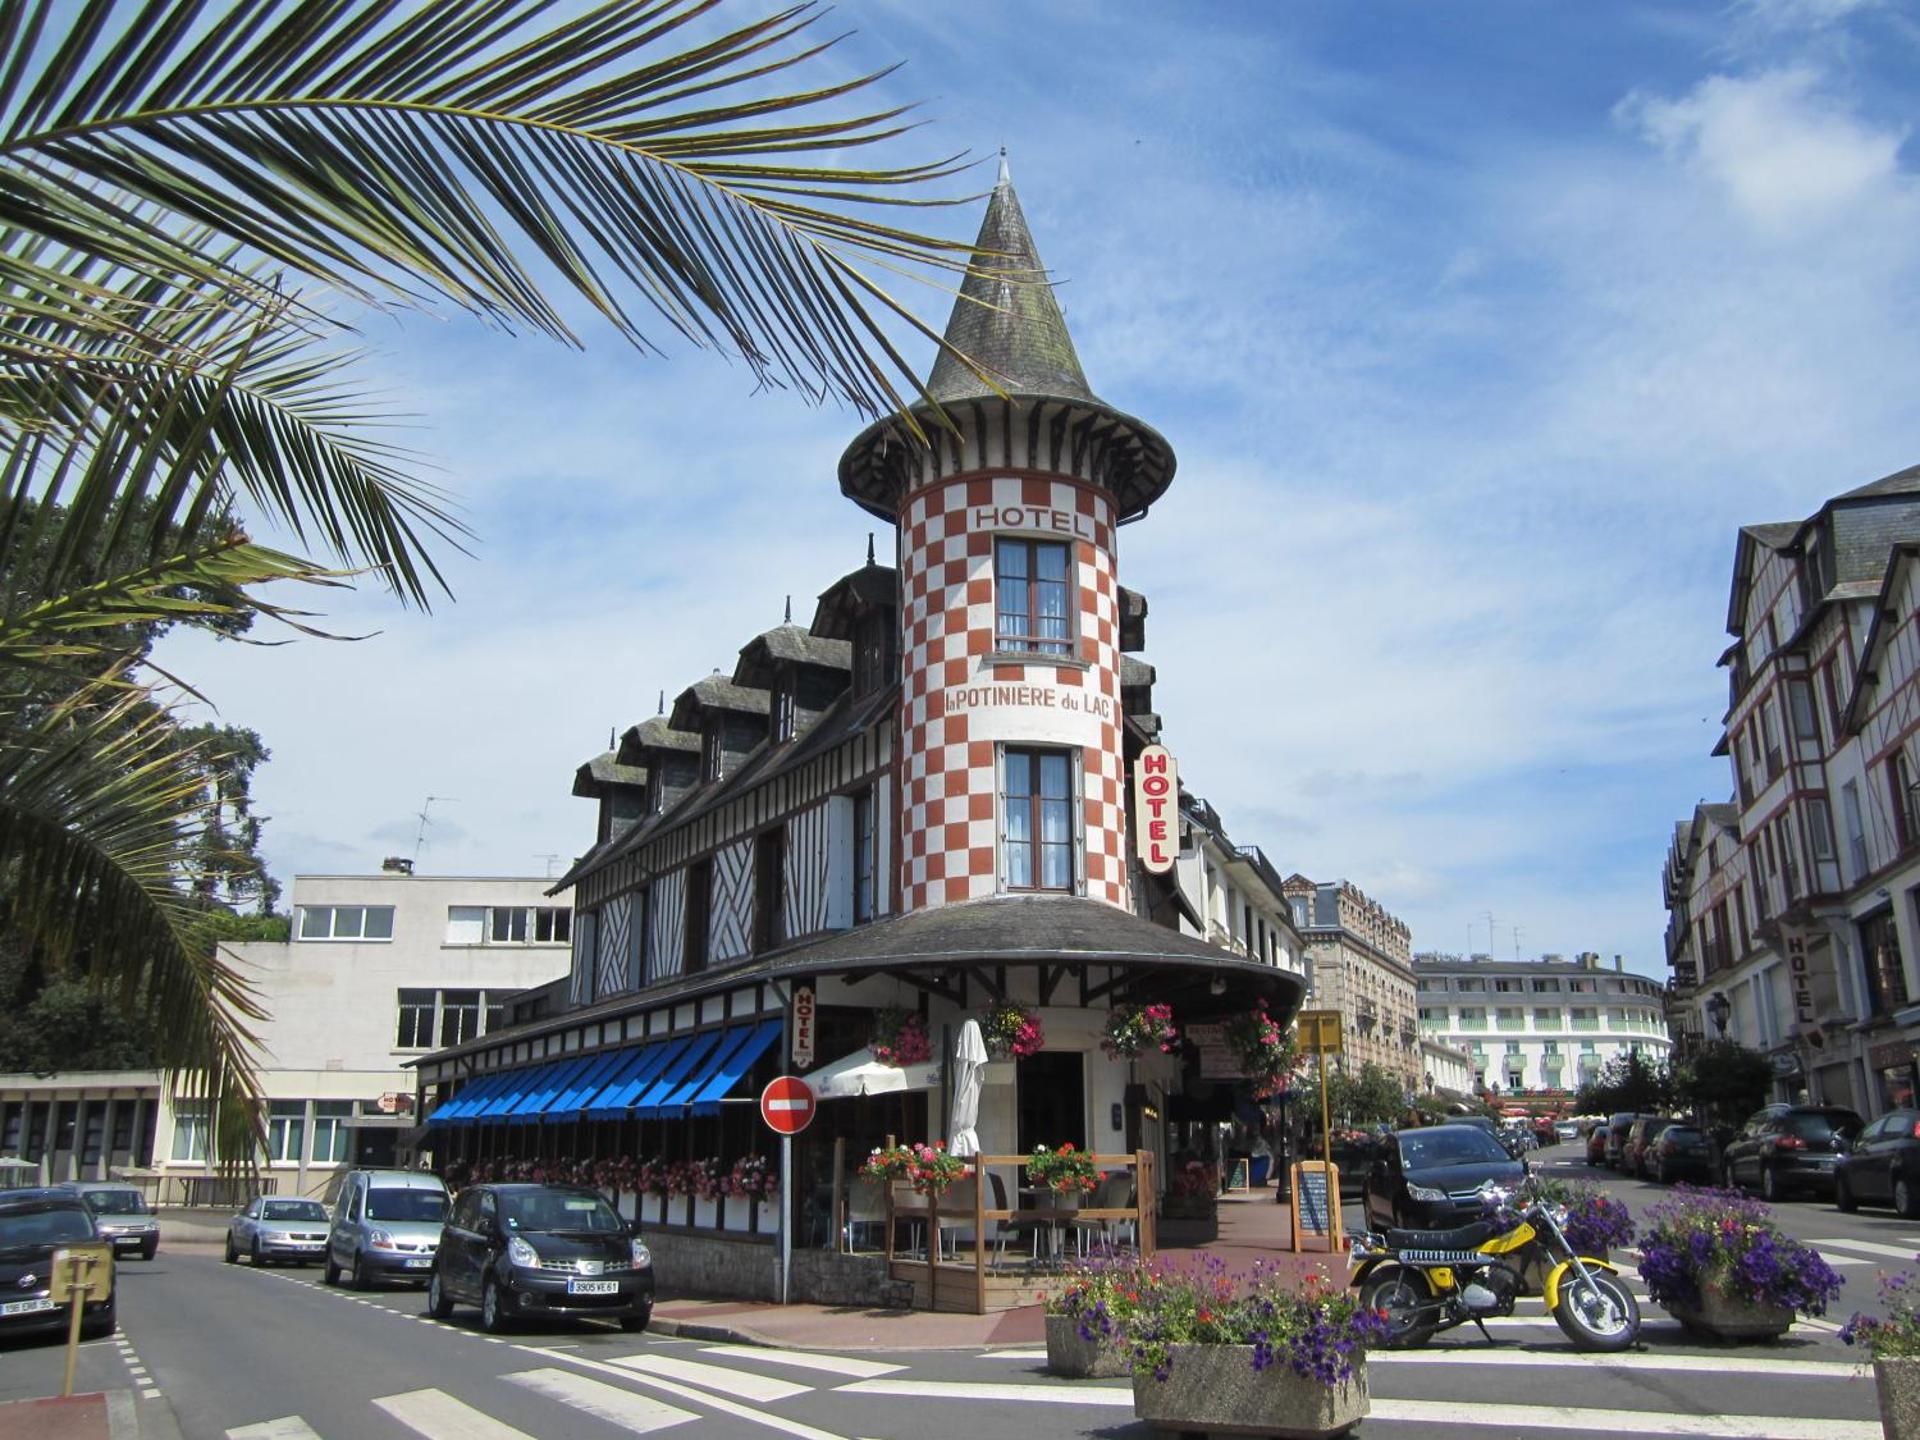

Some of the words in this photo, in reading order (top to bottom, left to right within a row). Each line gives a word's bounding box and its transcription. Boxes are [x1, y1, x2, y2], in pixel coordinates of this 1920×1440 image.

[976, 507, 1090, 538] HOTEL
[1061, 693, 1079, 710] du
[1084, 694, 1109, 718] LAC
[1142, 754, 1170, 863] HOTEL
[1788, 937, 1813, 1023] HOTEL
[797, 994, 812, 1049] HOTEL
